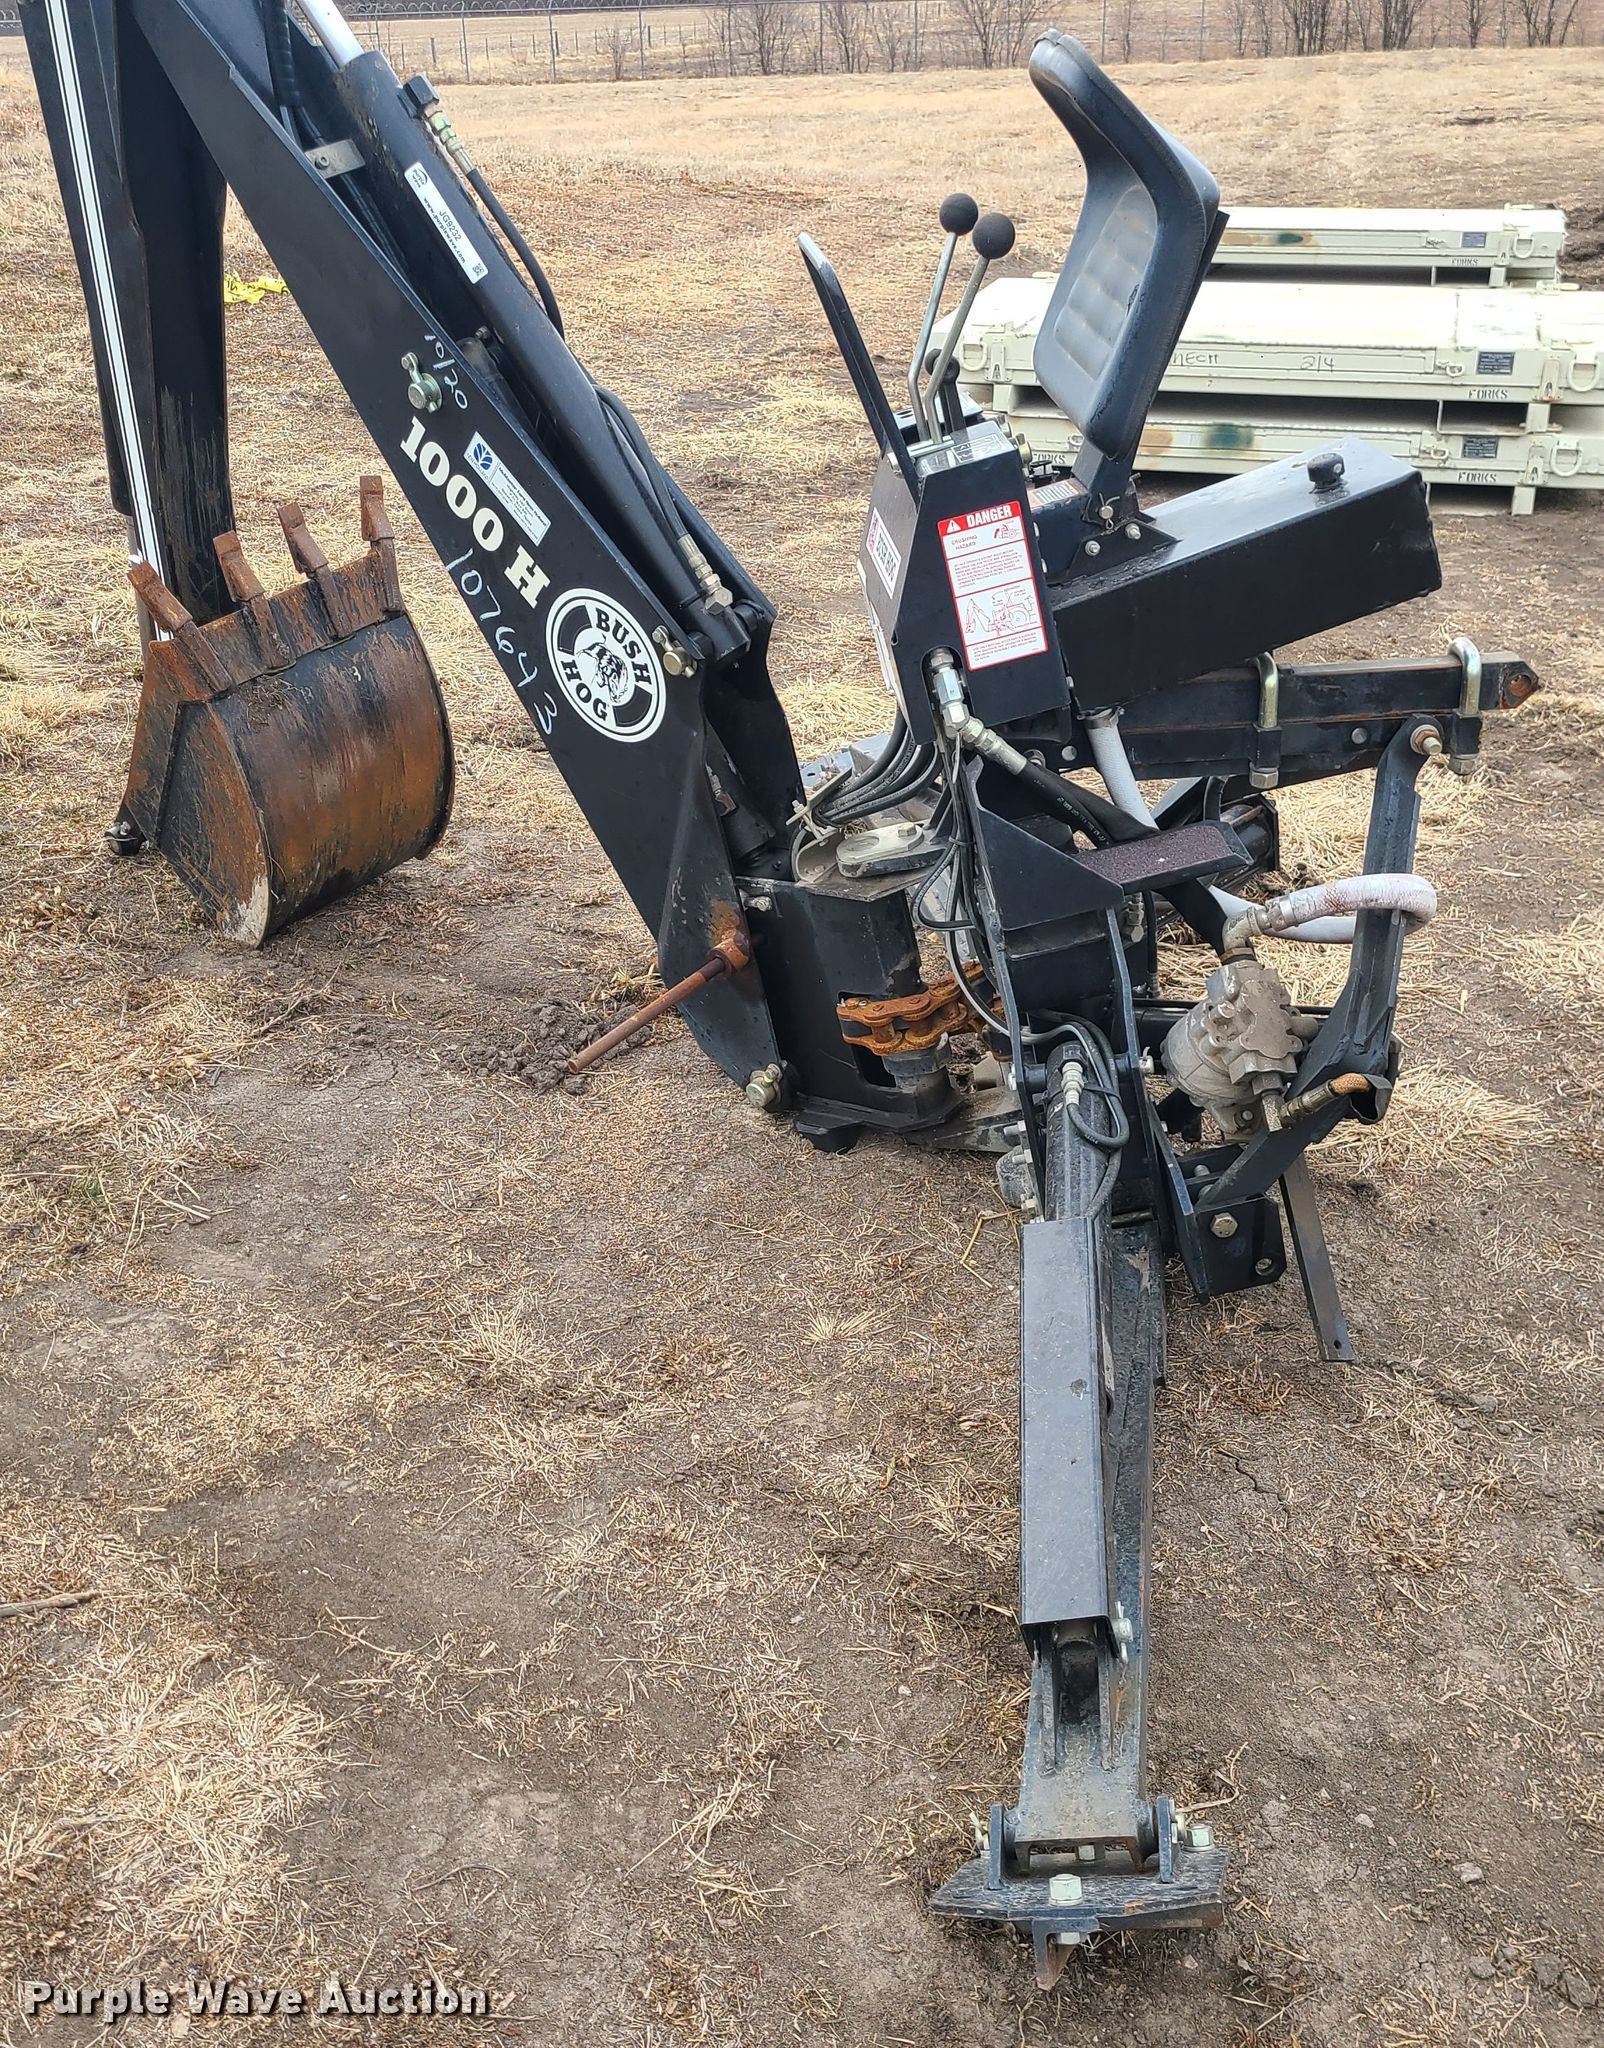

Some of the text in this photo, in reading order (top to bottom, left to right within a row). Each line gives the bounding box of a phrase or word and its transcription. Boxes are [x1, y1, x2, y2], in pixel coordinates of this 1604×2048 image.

[423, 197, 466, 264] www.purplewave.com
[439, 210, 462, 242] JG9232
[1451, 258, 1479, 267] FORKS
[1468, 389, 1508, 400] FORKS
[1458, 471, 1497, 483] FORKS
[400, 416, 504, 552] 1000
[504, 545, 551, 609] H
[966, 504, 1013, 528] DANGER
[445, 548, 558, 735] 107643
[595, 607, 653, 686] BUSH
[560, 659, 609, 722] HOG
